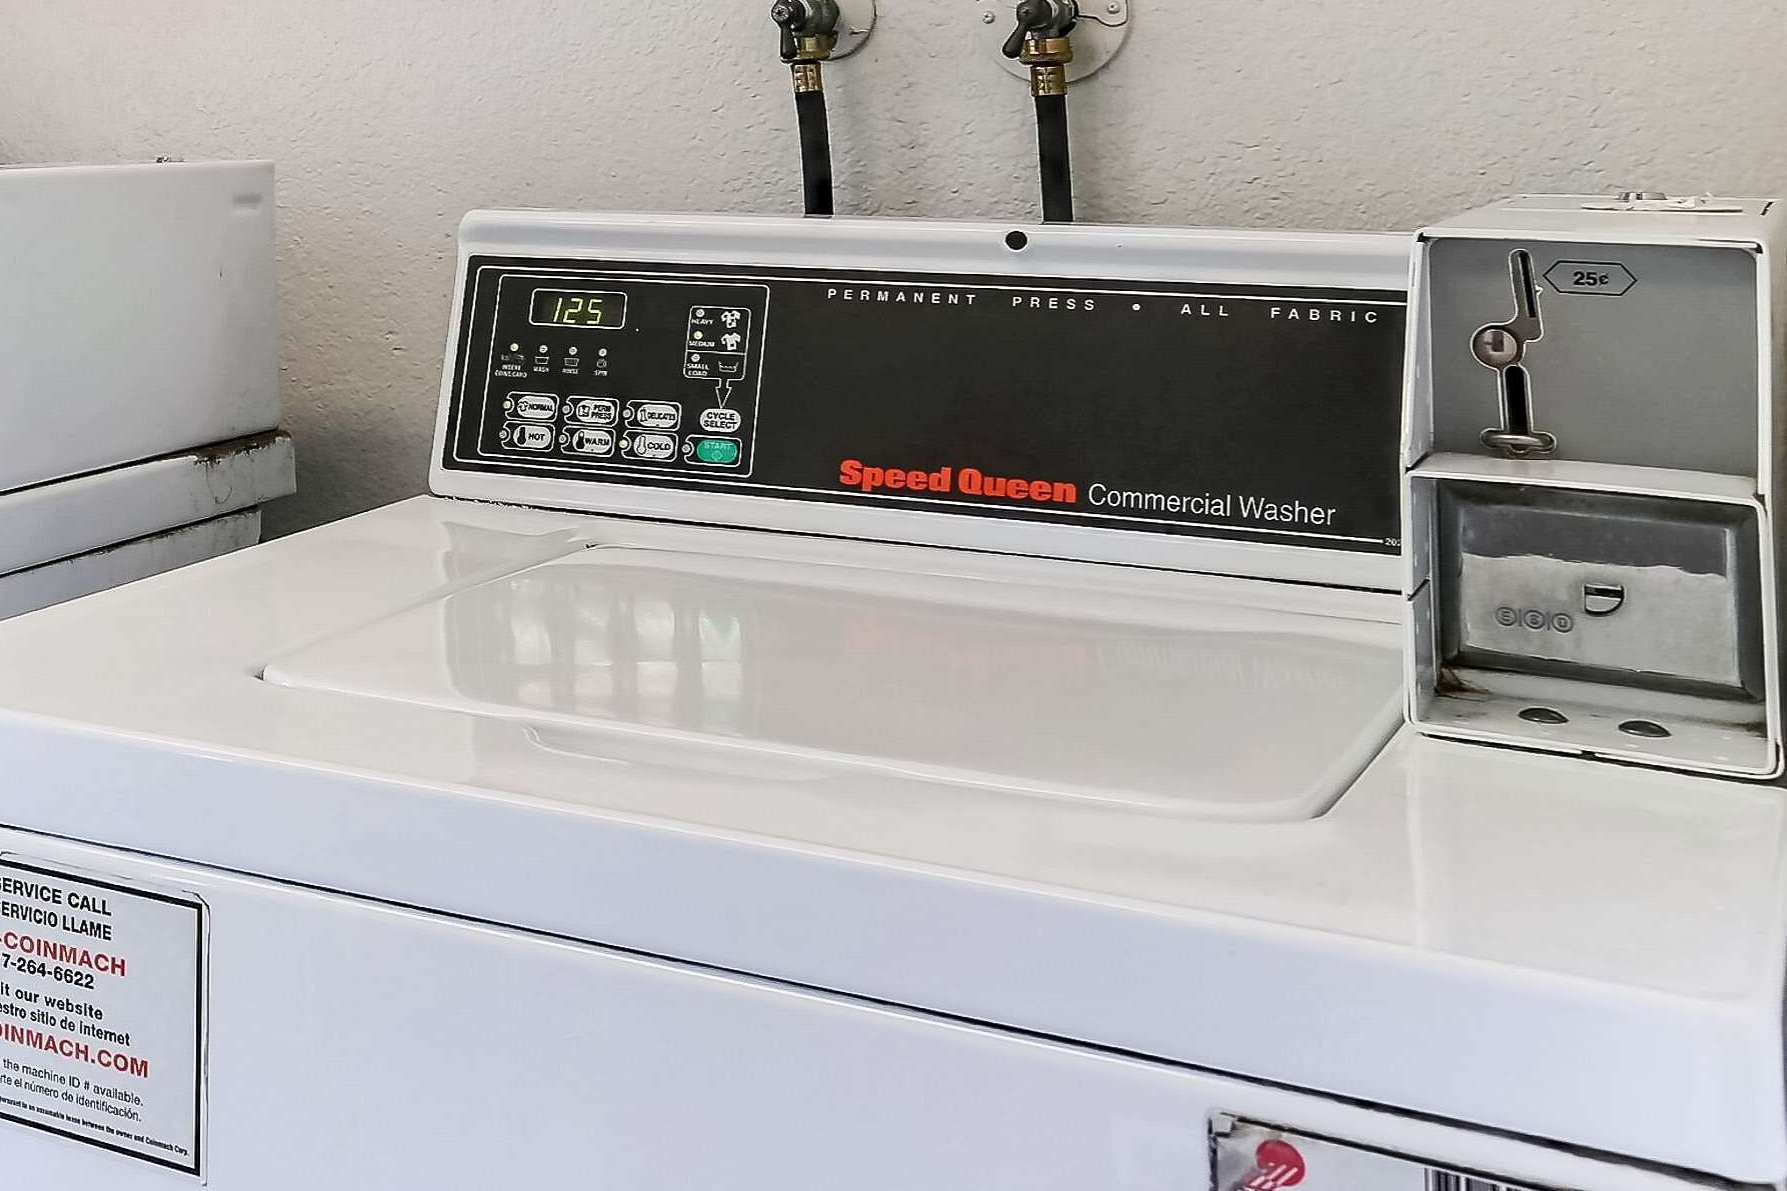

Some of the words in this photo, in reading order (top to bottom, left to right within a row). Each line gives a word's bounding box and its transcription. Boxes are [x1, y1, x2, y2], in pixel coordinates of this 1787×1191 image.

[553, 297, 603, 324] 125
[827, 288, 975, 304] PERMANENT
[1012, 296, 1094, 310] PRESS
[1180, 303, 1228, 316] ALL
[1270, 307, 1376, 323] FABRIC
[703, 419, 737, 430] SELECT
[706, 411, 736, 421] CYCLE
[528, 433, 546, 442] HOT
[585, 438, 610, 446] WARM
[647, 442, 671, 451] COLD
[839, 459, 951, 492] Speed
[958, 467, 1076, 503] Queen
[1088, 483, 1230, 516] Commercial
[1238, 495, 1336, 525] Washer
[67, 892, 111, 916] CALL
[62, 914, 111, 941] LLAME
[14, 988, 39, 1003] our
[44, 996, 102, 1020] website
[29, 1008, 56, 1026] sitio
[59, 1015, 75, 1032] de
[79, 1020, 129, 1046] internet
[2, 1058, 19, 1072] the
[21, 1065, 65, 1085] machine
[68, 1075, 80, 1088] ID
[93, 1084, 143, 1106] available.
